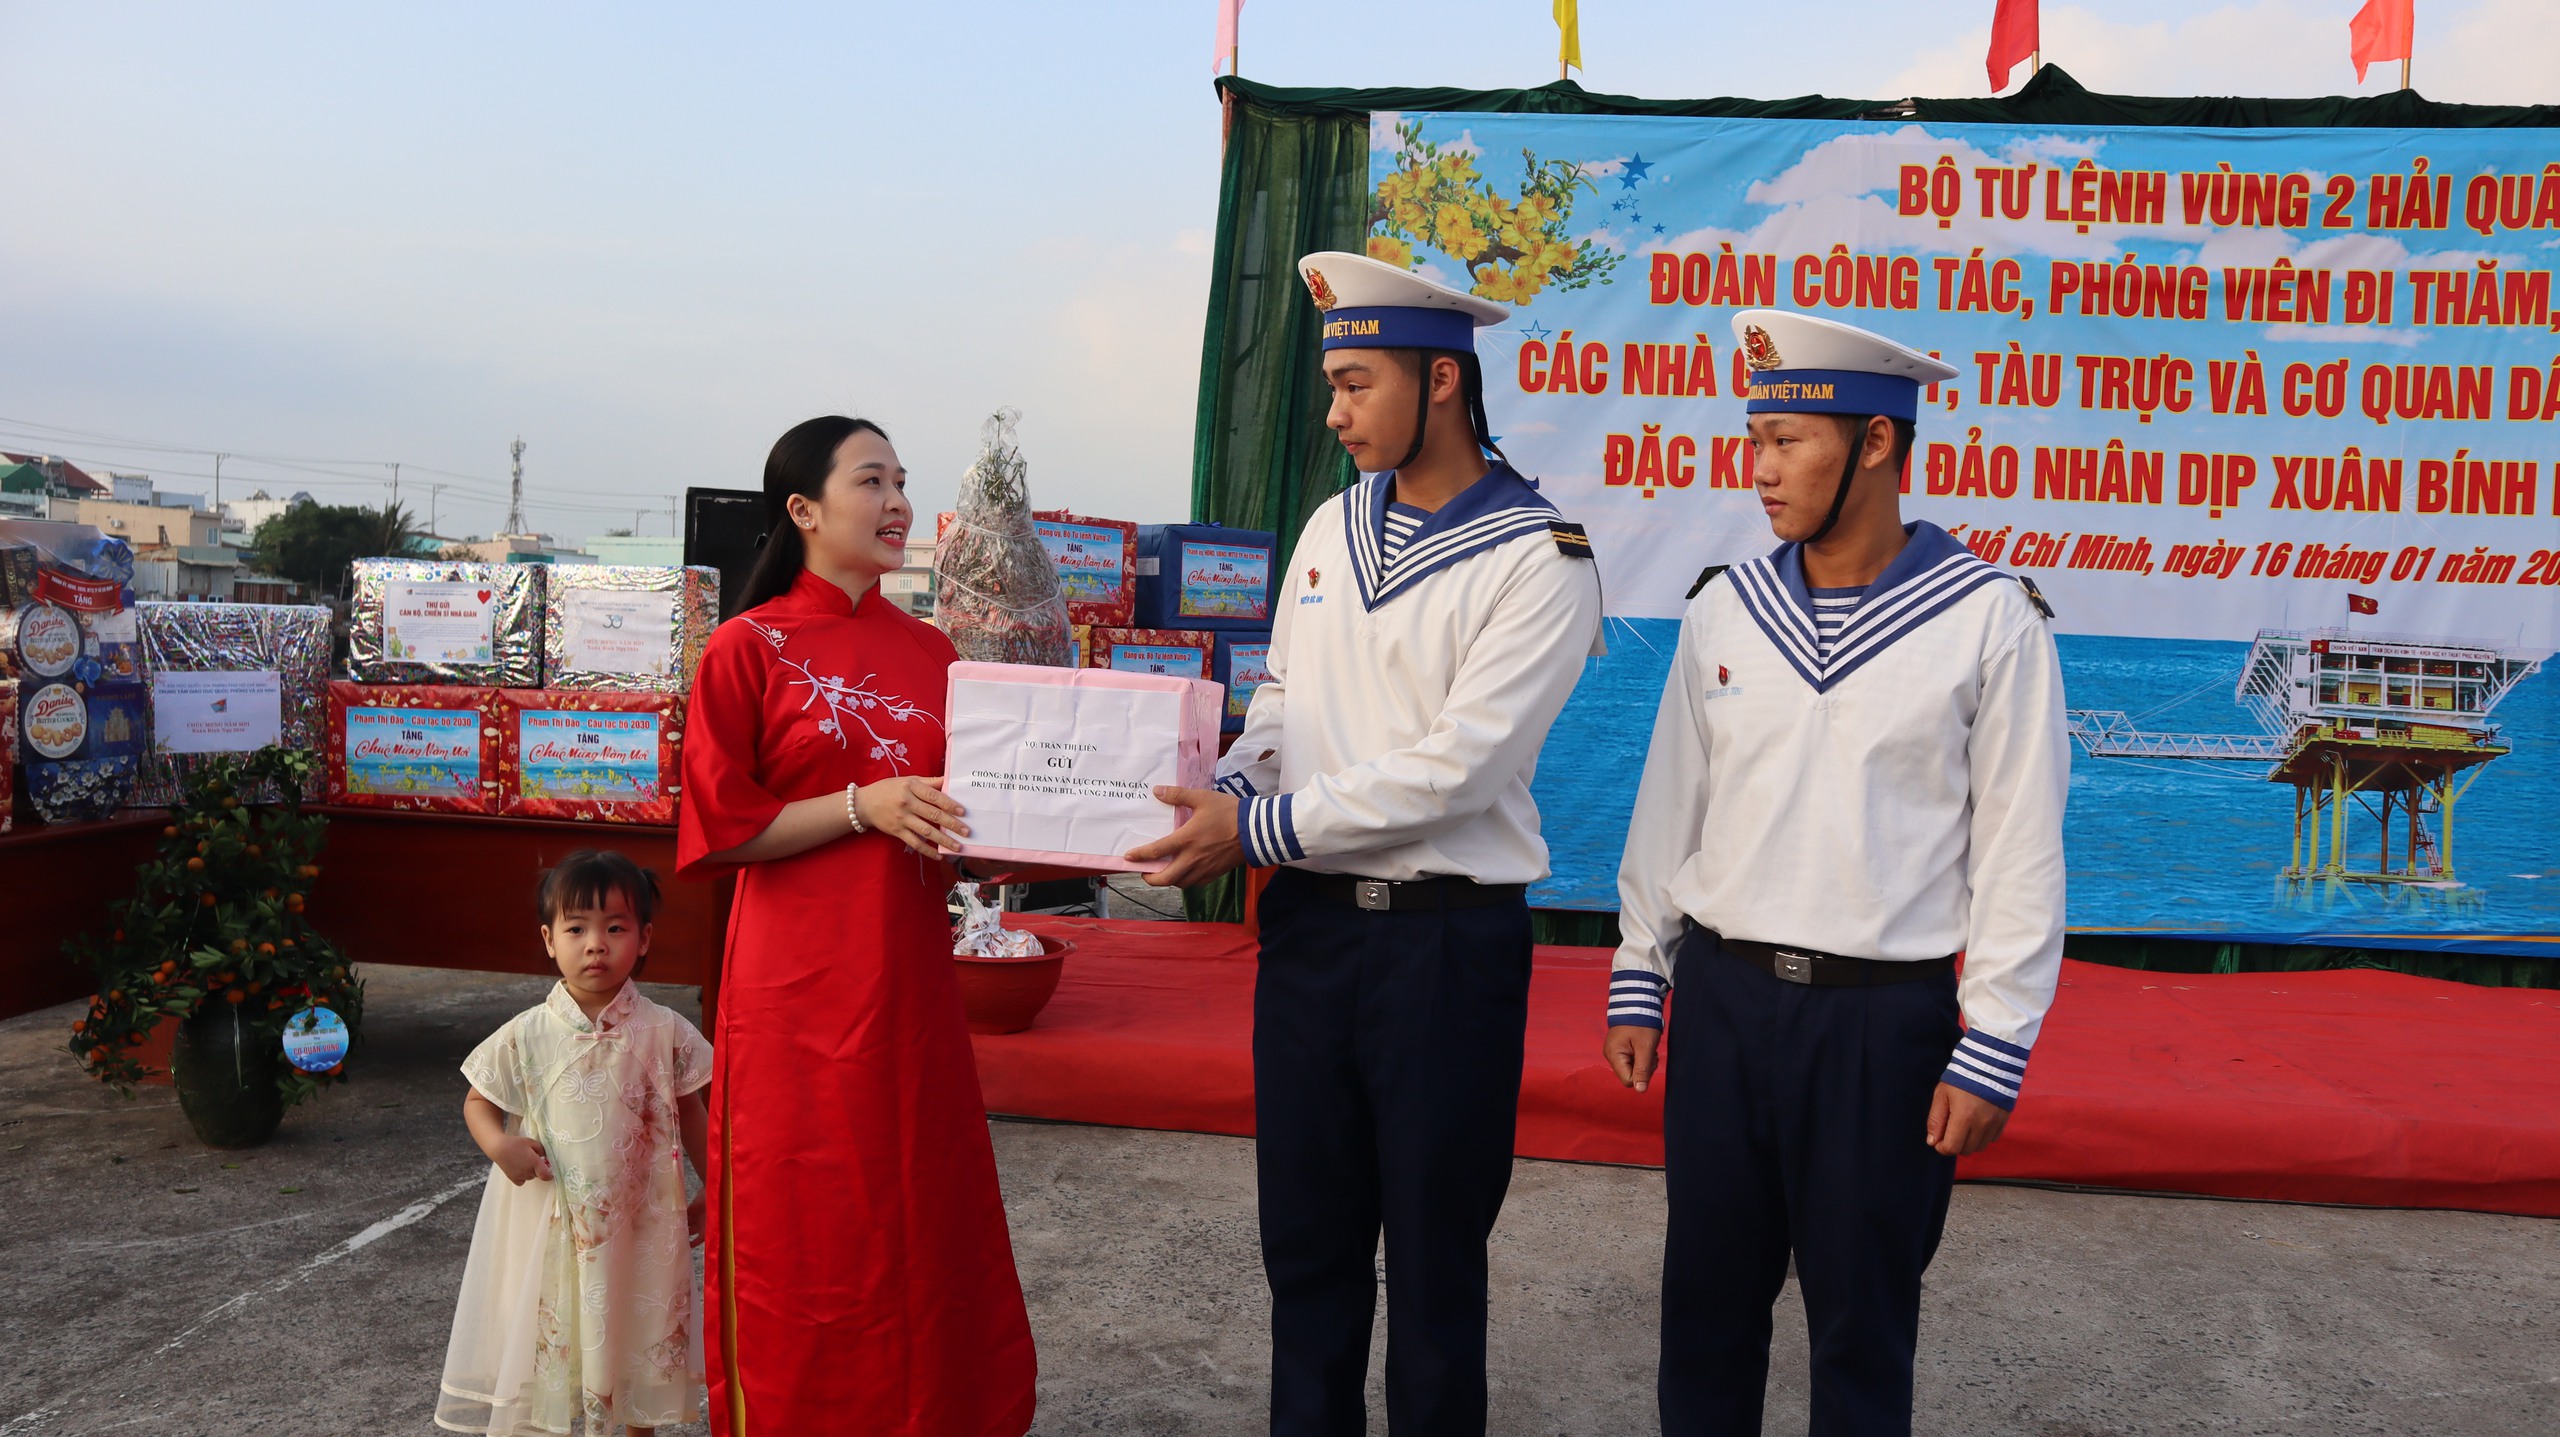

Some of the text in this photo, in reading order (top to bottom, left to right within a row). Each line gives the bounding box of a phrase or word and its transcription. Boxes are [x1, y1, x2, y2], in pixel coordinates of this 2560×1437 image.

[1898, 155, 1962, 231] BỘ
[1974, 163, 2038, 221] TƯ
[2044, 158, 2167, 236] LỆNH
[2180, 161, 2311, 229] VÙNG
[2321, 174, 2356, 229] 2
[2367, 156, 2453, 230] HẢI
[1648, 242, 2560, 334] ĐOÀN CÔNG TÁC, PHÓNG VIÊN ĐI THĂM,
[1329, 317, 1350, 340] VIỆT
[1351, 319, 1380, 336] NAM
[1518, 330, 1609, 395] CÁC
[1622, 333, 1718, 398] NHÀ
[1973, 341, 2063, 409] TÀU
[2076, 352, 2194, 424] TRỰC
[2208, 349, 2268, 416] VÀ
[2282, 358, 2350, 419] CƠ
[2360, 363, 2494, 426] QUAN
[1771, 379, 1801, 403] VIỆT
[1801, 383, 1835, 400] NAM
[1603, 423, 1697, 500] ĐẶC
[1924, 425, 2020, 500] ĐẢO
[2033, 438, 2165, 505] NHÂN
[2177, 452, 2257, 520] DỊP
[2269, 445, 2404, 513] XUÂN
[2416, 448, 2538, 517] BÍNH
[1067, 543, 1083, 554] TẶNG
[1964, 525, 2013, 565] Hồ
[2008, 531, 2072, 569] Chí
[2066, 533, 2155, 576] Minh,
[2162, 538, 2248, 581] ngày
[2250, 541, 2294, 578] 16
[2292, 541, 2390, 586] tháng
[2389, 545, 2437, 583] 01
[2437, 545, 2518, 585] năm
[1219, 562, 1233, 573] TẶNG
[74, 593, 92, 606] TẶNG
[28, 616, 66, 637] Danisa
[1150, 663, 1165, 674] TẶNG
[35, 695, 75, 717] Danisa
[354, 714, 374, 725] Phạm
[377, 714, 388, 726] Thị
[390, 715, 404, 724] Đào
[453, 718, 471, 726] 2030
[528, 717, 549, 728] Phạm
[552, 718, 563, 729] Thị
[565, 718, 580, 728] Đào
[631, 720, 650, 729] 2030
[402, 729, 423, 742] TẶNG
[577, 733, 599, 746] TẶNG
[1064, 743, 1077, 752] THỊ
[1047, 755, 1073, 769] GỬI
[1003, 772, 1017, 782] ĐẠI
[1091, 779, 1108, 787] CTV
[1109, 779, 1127, 789] NHÀ
